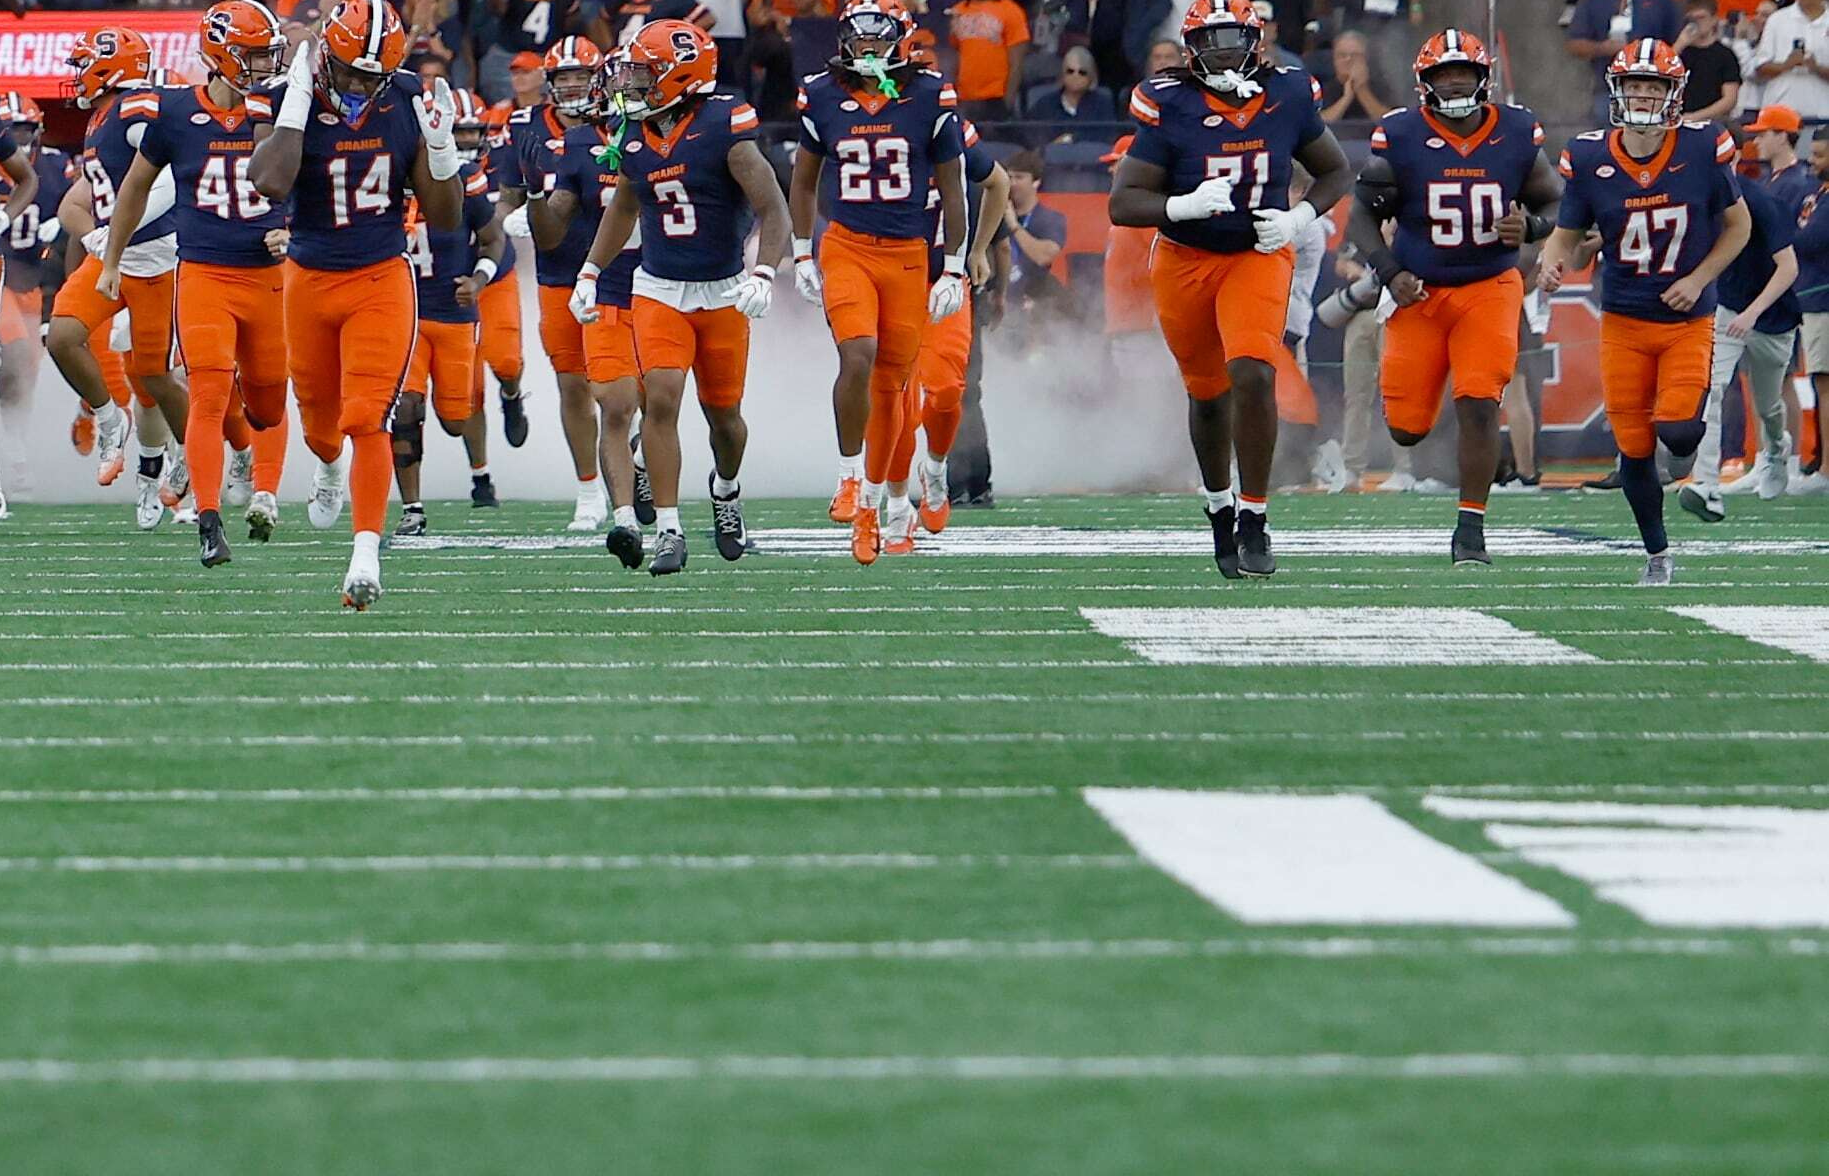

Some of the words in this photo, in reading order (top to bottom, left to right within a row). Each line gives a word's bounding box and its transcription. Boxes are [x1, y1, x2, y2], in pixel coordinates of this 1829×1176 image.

[522, 0, 551, 46] 4
[94, 29, 118, 60] S
[672, 30, 699, 64] S
[335, 137, 385, 152] ORANGE
[851, 124, 893, 135] ORANGE
[209, 140, 254, 151] ORANGE
[1221, 139, 1265, 152] ORANGE
[598, 174, 620, 185] ORA
[647, 164, 687, 182] ORANGE
[836, 137, 912, 202] 23
[1205, 151, 1270, 210] 71
[1443, 168, 1487, 178] ORANGE
[329, 153, 393, 228] 14
[1625, 193, 1670, 208] ORANGE
[652, 179, 698, 238] 3
[1427, 181, 1504, 249] 50
[1619, 203, 1689, 277] 47
